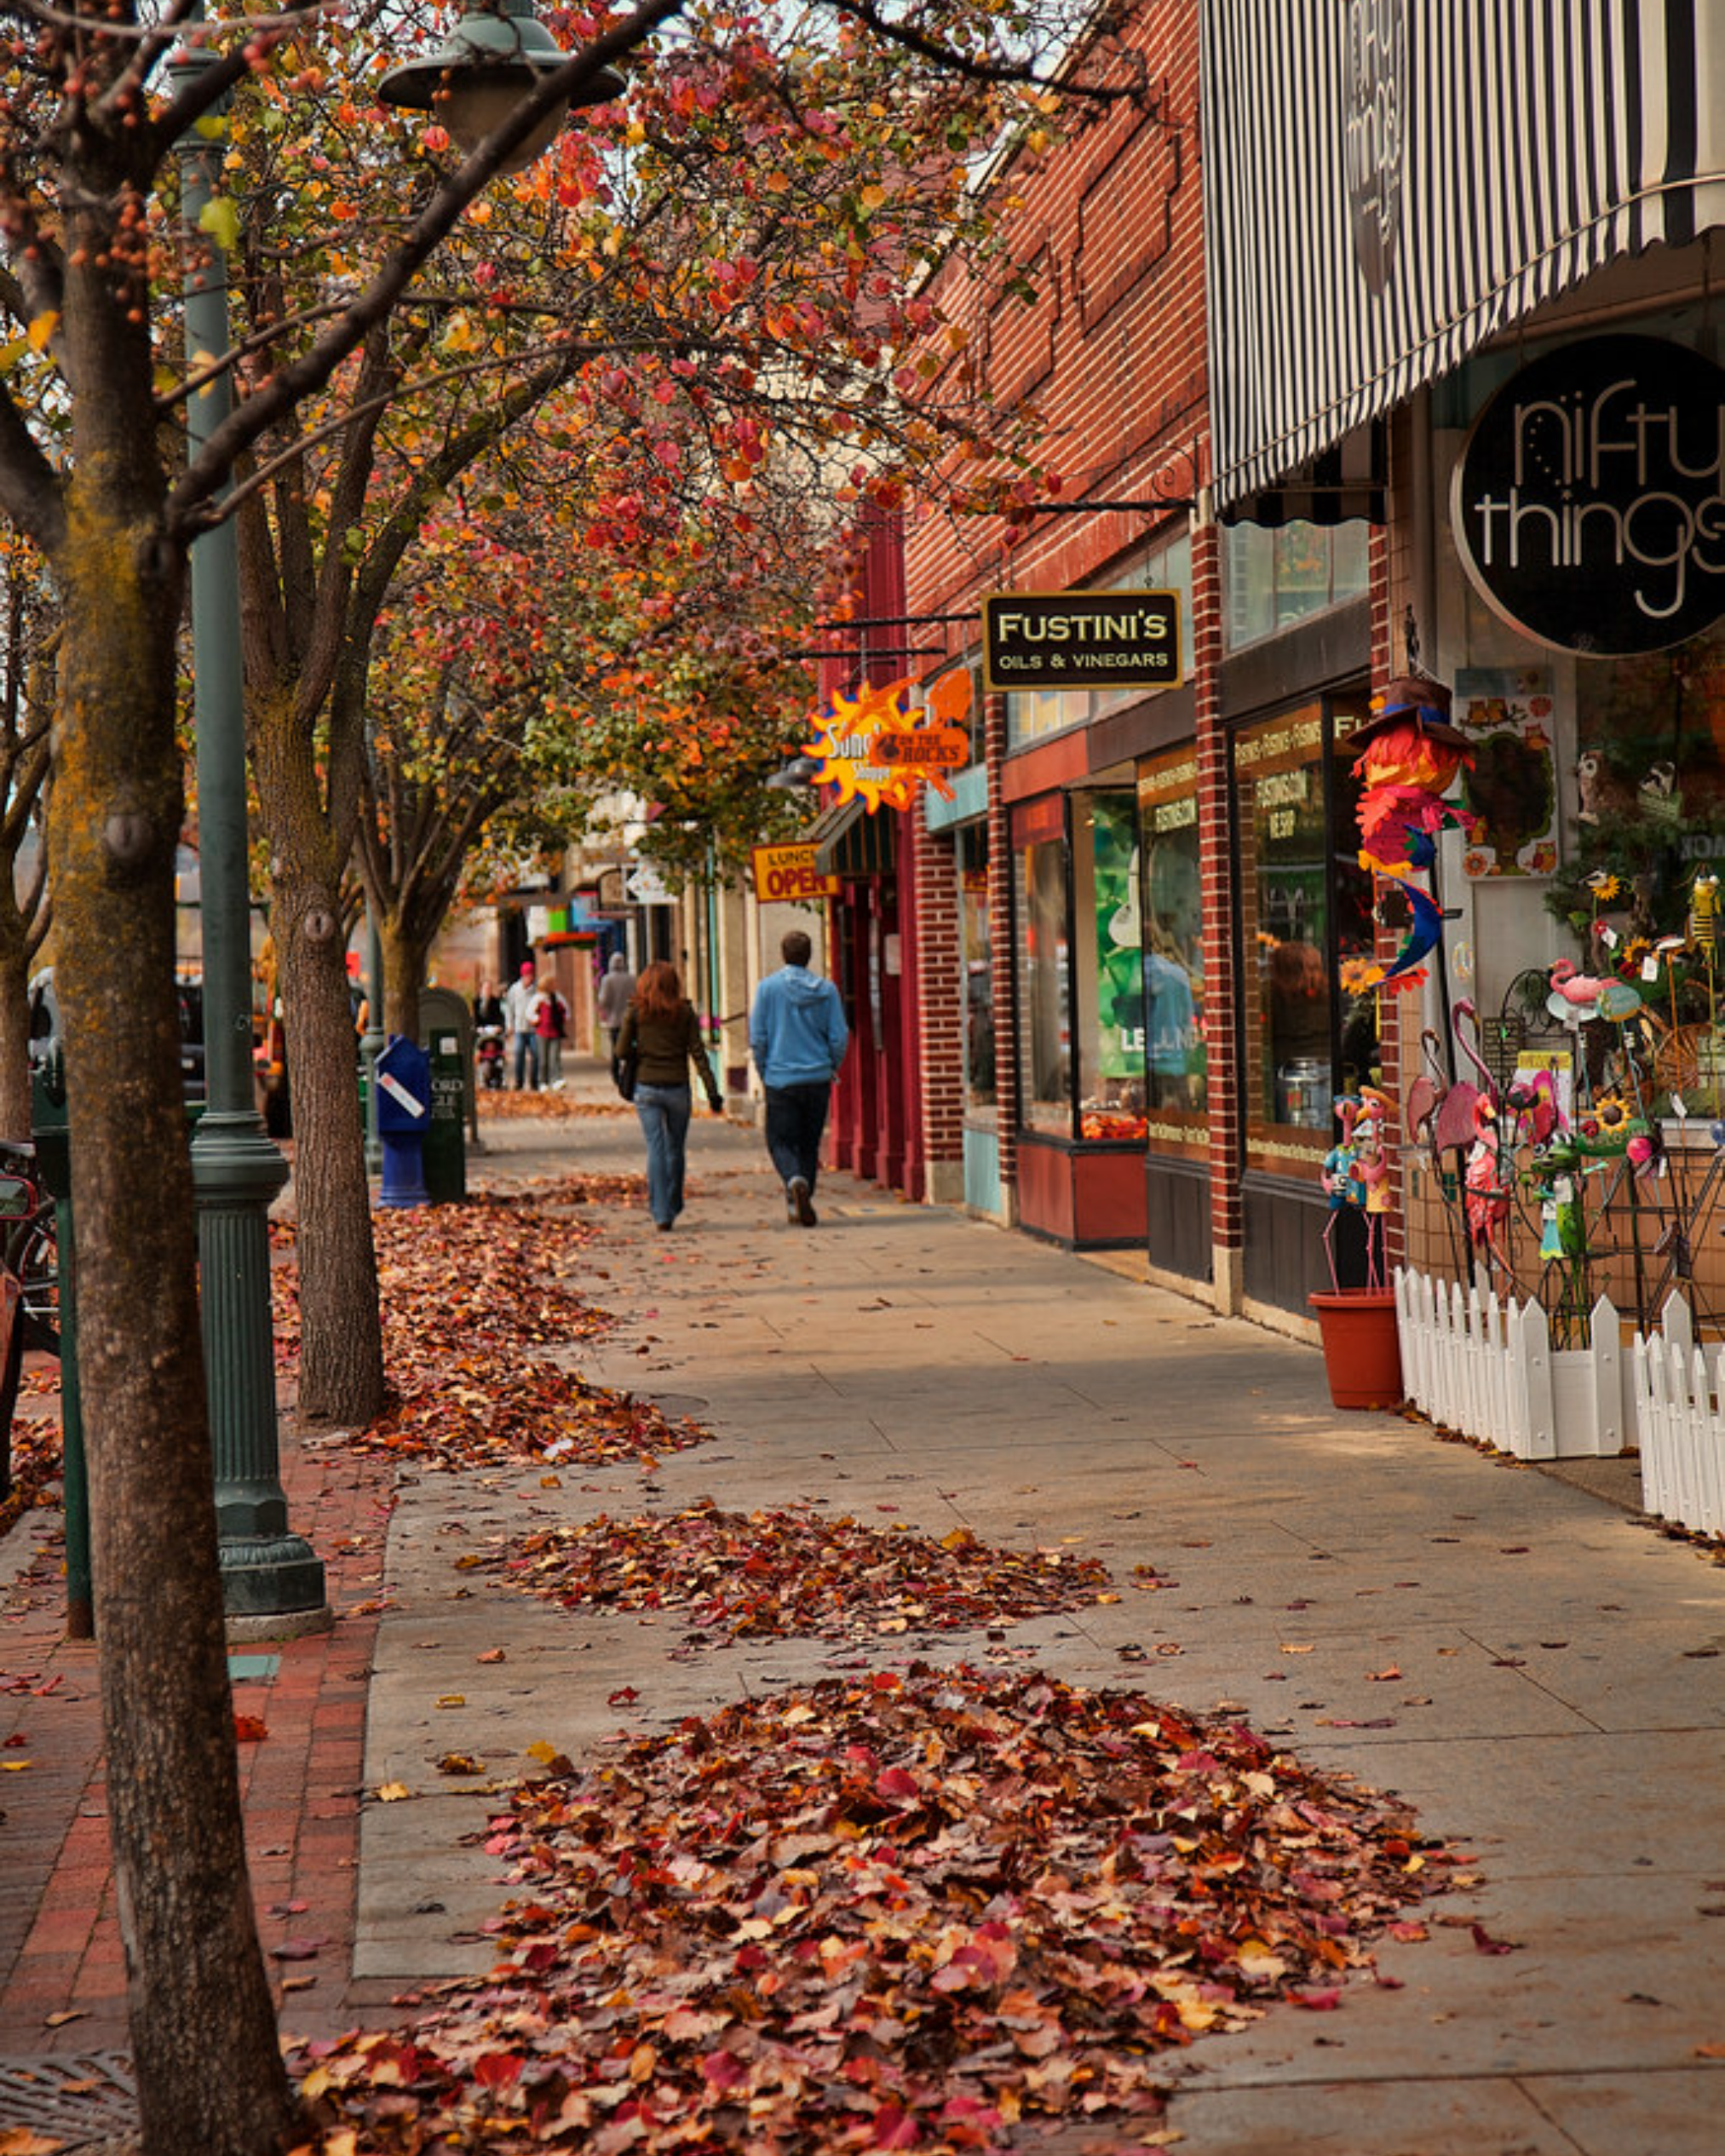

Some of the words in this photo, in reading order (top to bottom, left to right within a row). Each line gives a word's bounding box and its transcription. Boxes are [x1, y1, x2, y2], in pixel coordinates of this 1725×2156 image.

[1514, 380, 1725, 504] nifty
[1475, 486, 1725, 618] things
[998, 608, 1168, 641] FUSTINI'S
[999, 655, 1043, 670] OILS
[1050, 653, 1066, 669] &
[1073, 653, 1168, 667] VINEGARS
[904, 745, 960, 762] ROCKS
[768, 866, 827, 896] OPEN
